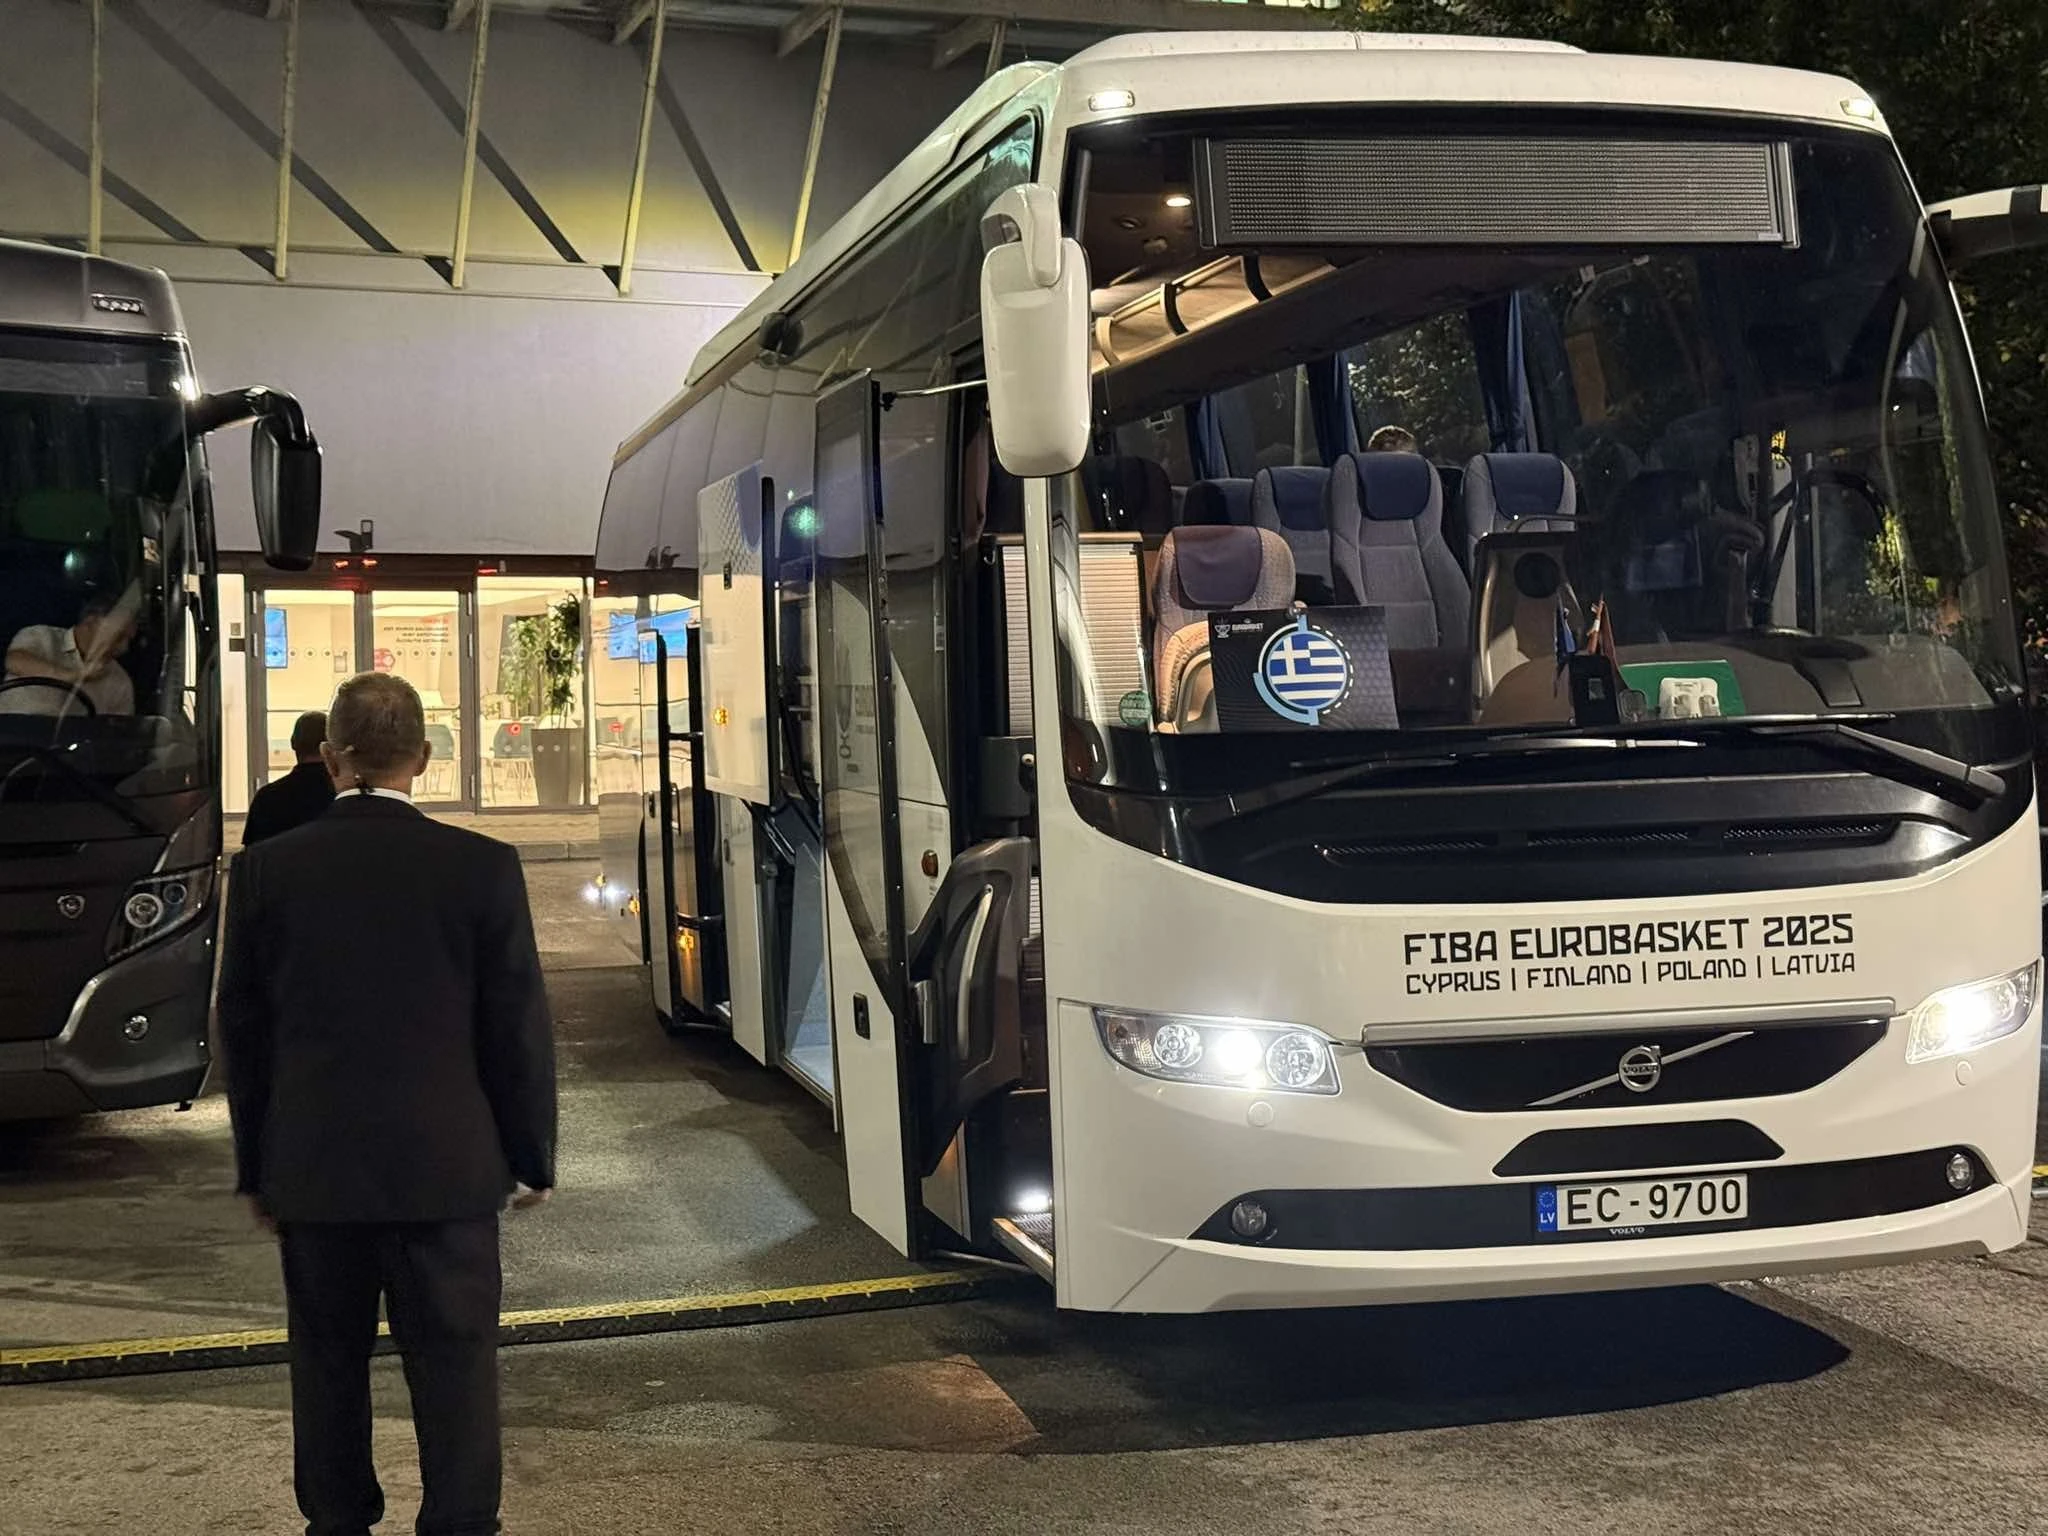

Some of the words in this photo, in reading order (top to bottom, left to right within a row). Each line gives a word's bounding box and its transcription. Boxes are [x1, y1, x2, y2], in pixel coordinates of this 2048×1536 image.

[1403, 930, 1498, 966] FIBA
[1510, 918, 1750, 961] EUROBASKET
[1762, 913, 1854, 948] 2025
[1406, 970, 1501, 995] CYPRUS
[1527, 963, 1632, 989] FINLAND
[1657, 958, 1747, 982] POLAND
[1771, 952, 1855, 976] LATVIA
[1540, 1212, 1555, 1224] LV
[1567, 1179, 1741, 1225] EC-9700
[1609, 1226, 1646, 1235] VOLVO
